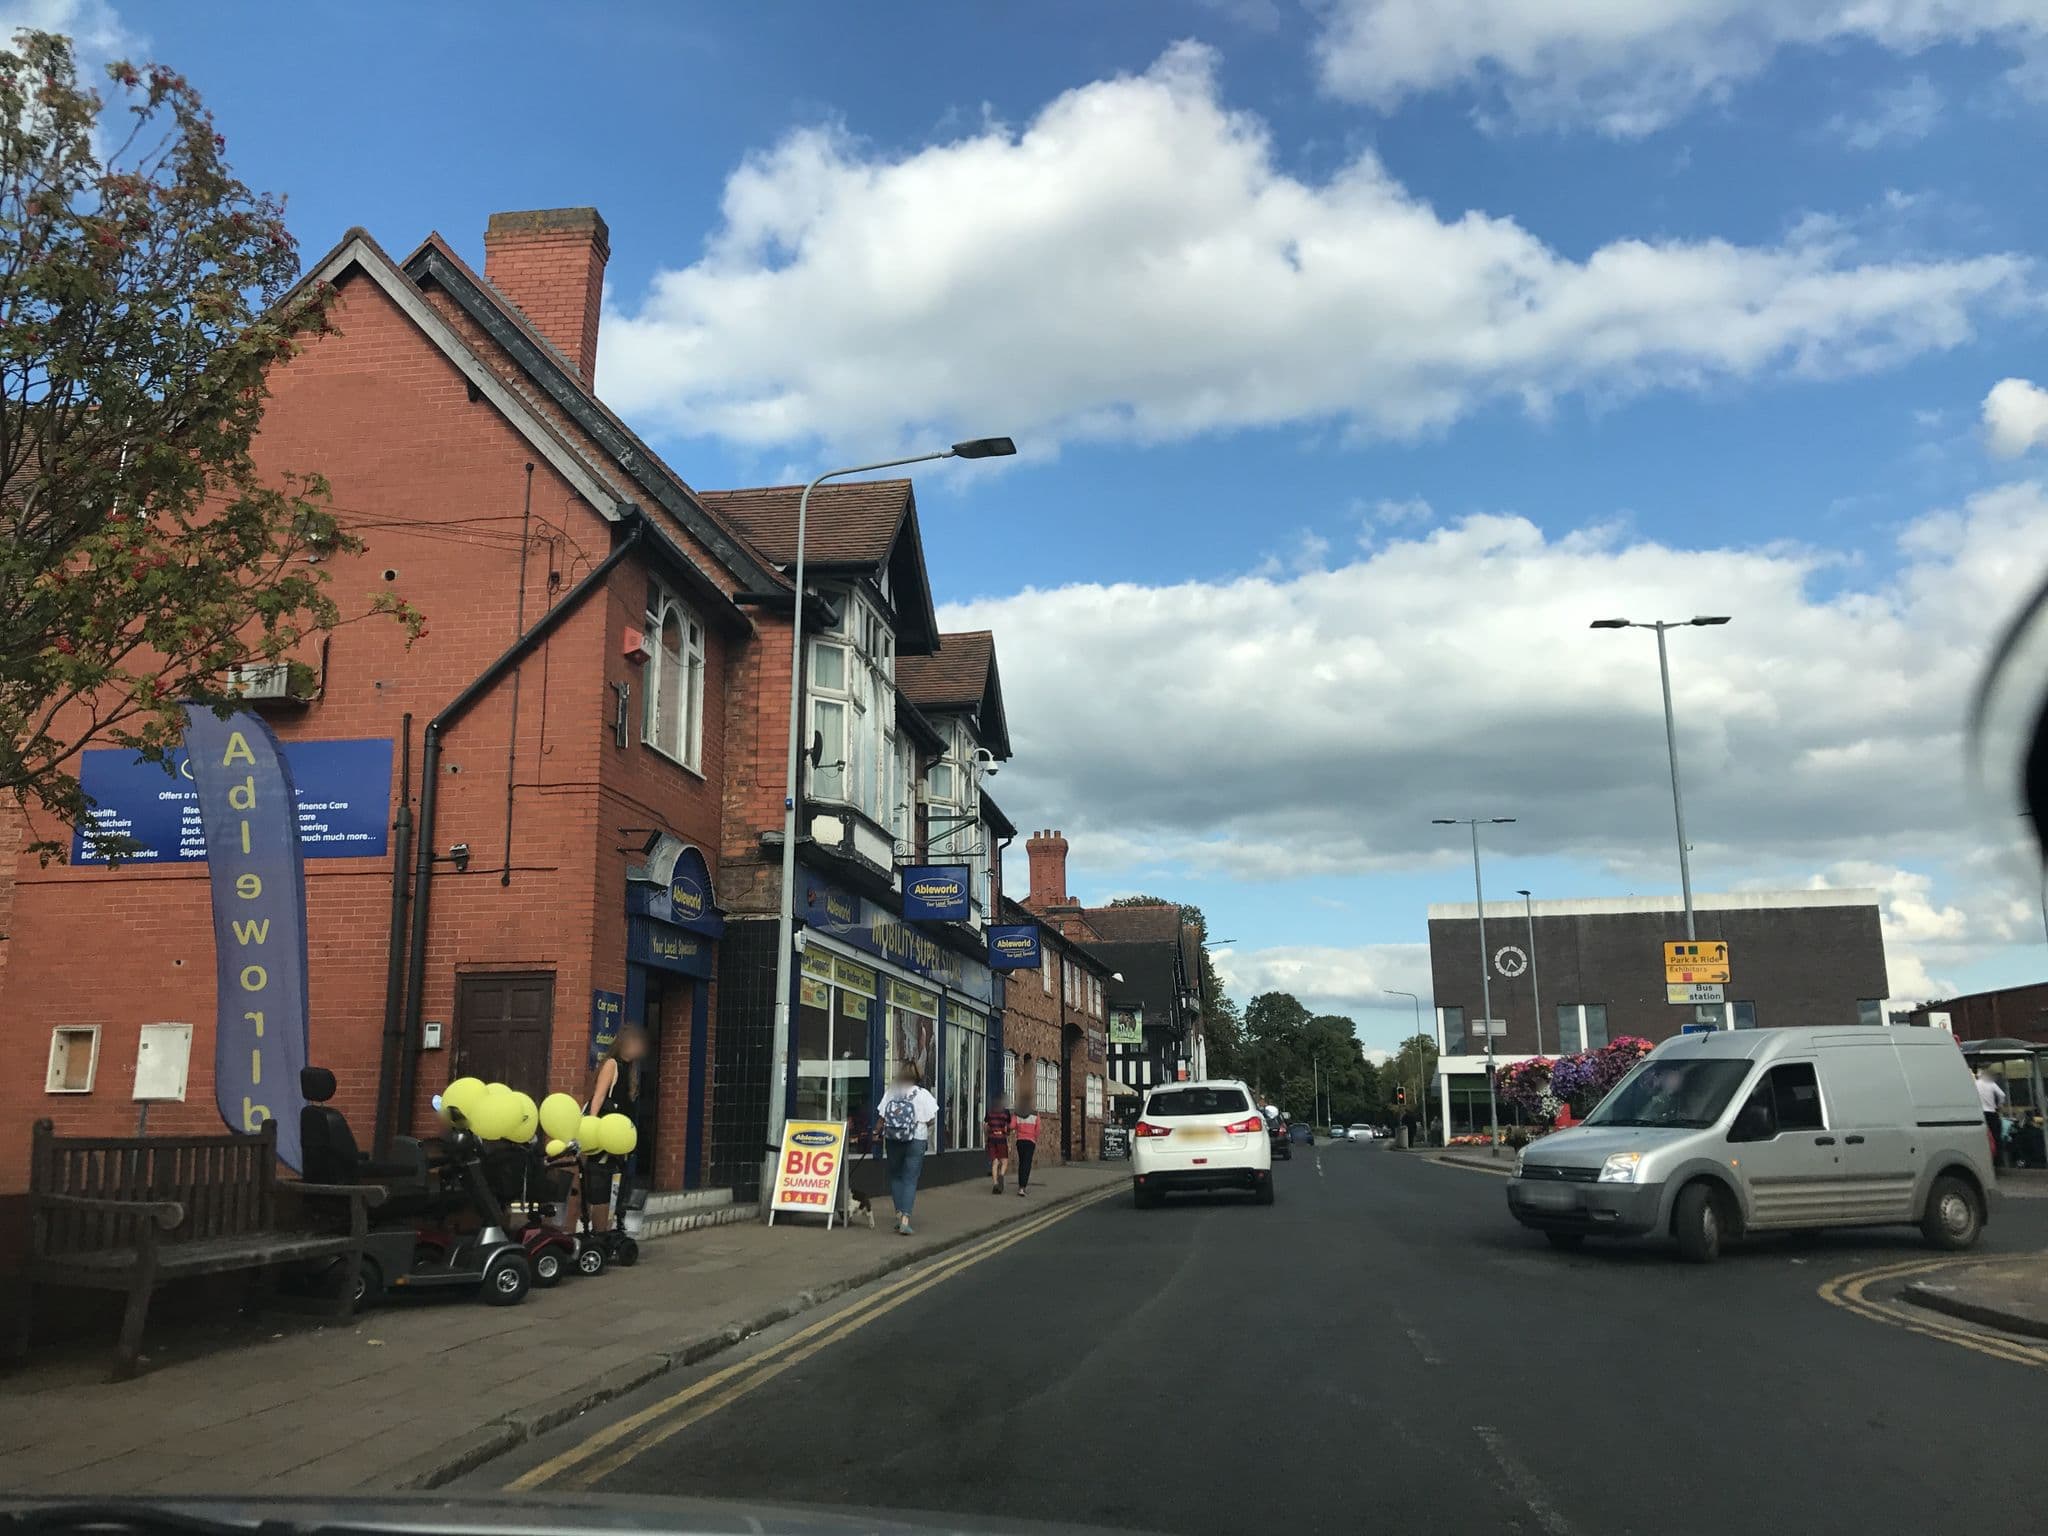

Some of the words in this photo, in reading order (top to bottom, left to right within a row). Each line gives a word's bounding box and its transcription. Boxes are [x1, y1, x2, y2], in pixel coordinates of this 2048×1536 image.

[159, 792, 182, 800] Offers
[329, 801, 348, 809] Care
[86, 808, 117, 818] airlifts
[85, 819, 132, 828] eelchairs
[181, 827, 201, 835] Back
[322, 832, 345, 841] much
[914, 884, 958, 894] Ableworld
[872, 911, 914, 960] MOBILITY
[997, 940, 1031, 948] Ableworld
[1670, 956, 1689, 964] Park
[1689, 992, 1721, 1001] station
[795, 1134, 833, 1142] Ableworld
[786, 1150, 834, 1176] BIG
[783, 1177, 831, 1189] SUMMER
[784, 1192, 825, 1204] SALE
